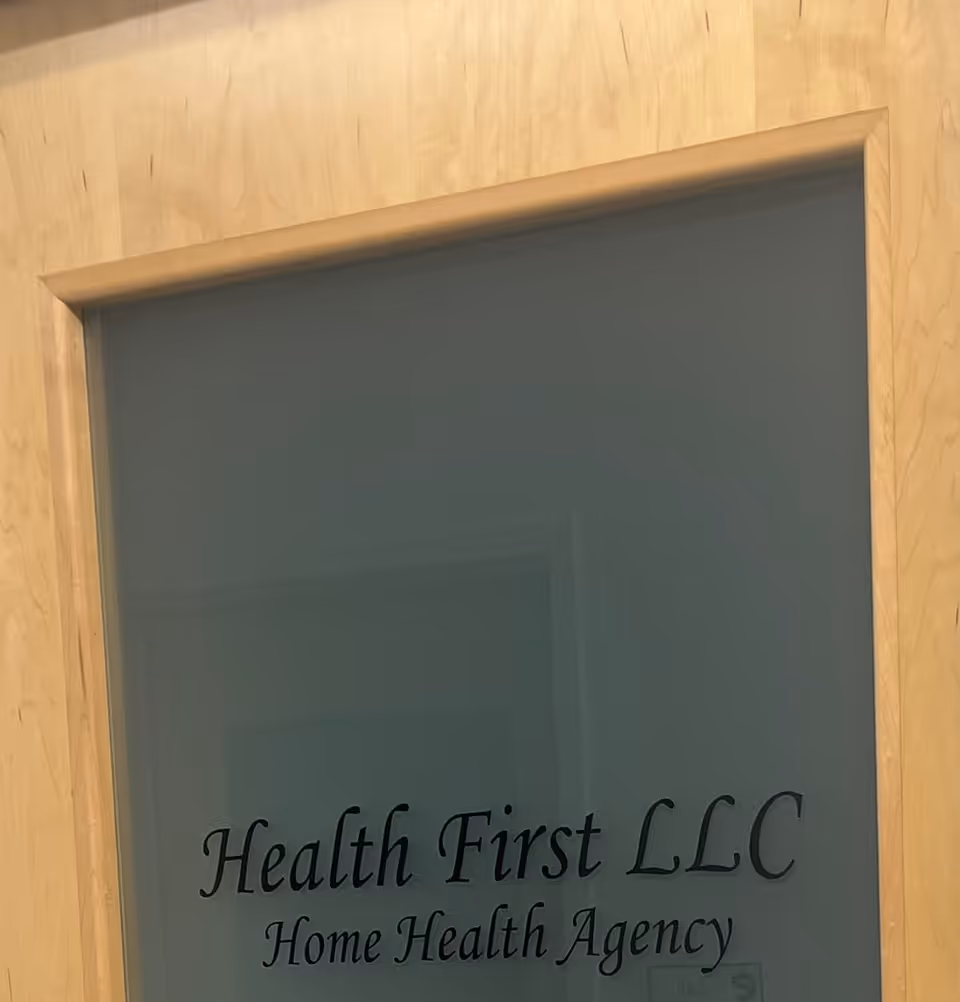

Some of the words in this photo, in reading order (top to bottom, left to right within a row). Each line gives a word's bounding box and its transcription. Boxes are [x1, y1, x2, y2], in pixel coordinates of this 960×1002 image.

[200, 803, 413, 898] Health
[439, 804, 601, 884] First
[626, 791, 803, 880] LLC
[262, 916, 382, 967] Home
[394, 902, 547, 963] Health
[556, 907, 733, 976] Agency
